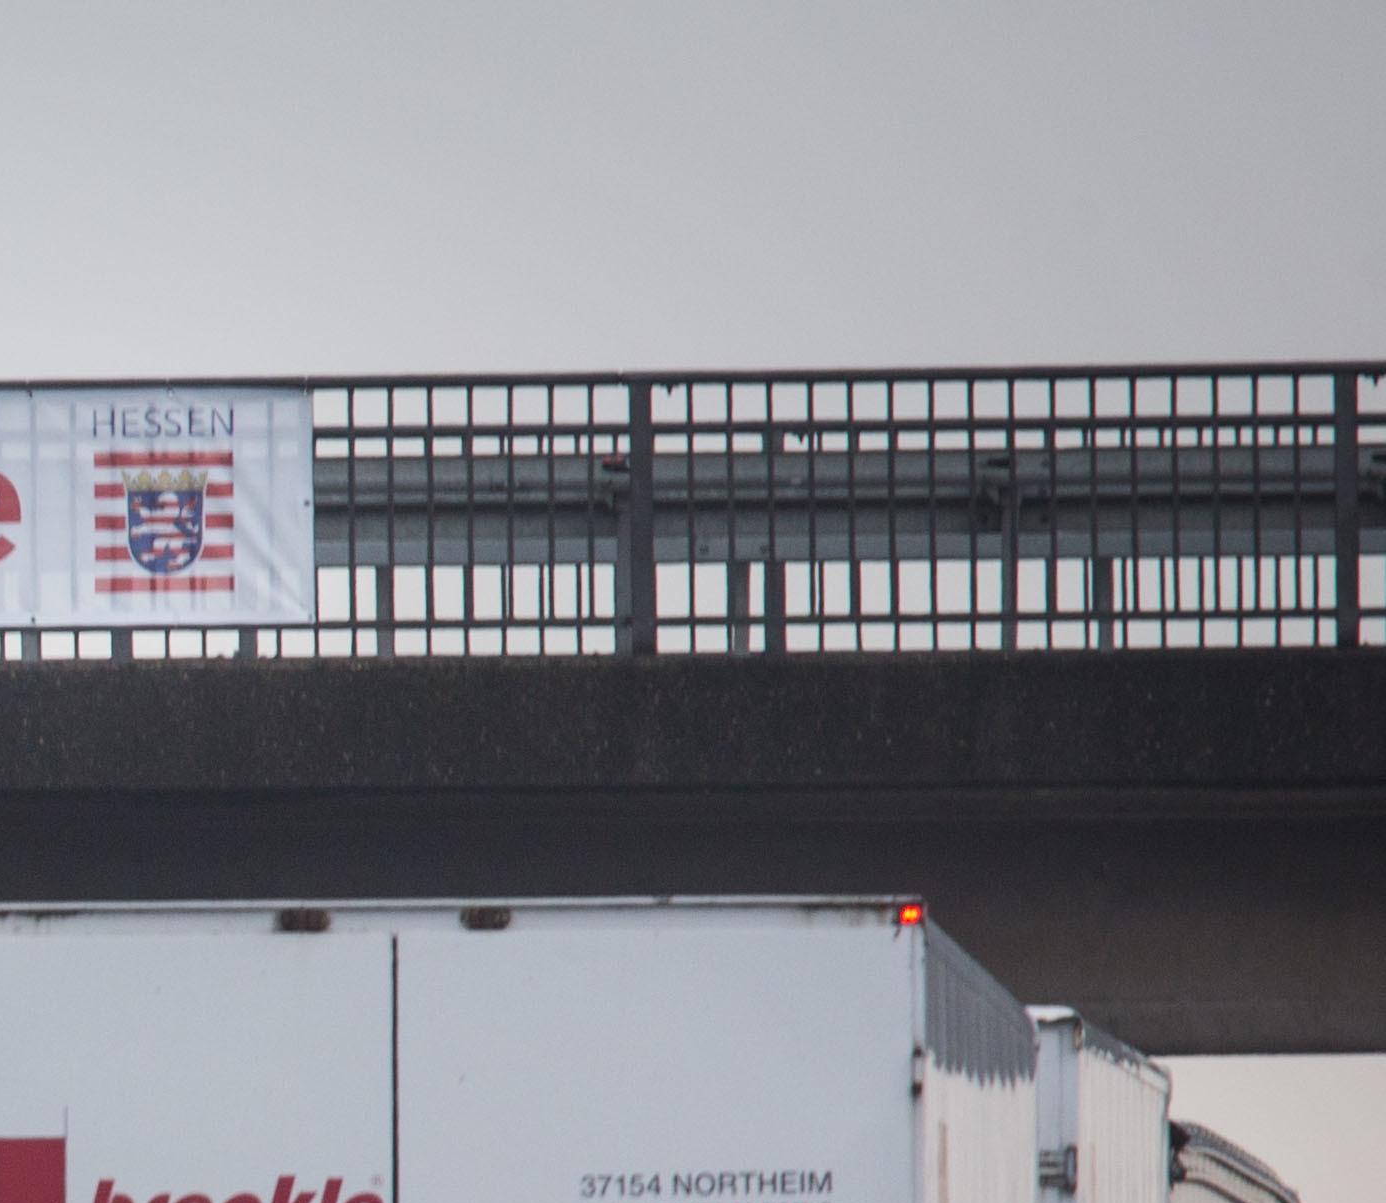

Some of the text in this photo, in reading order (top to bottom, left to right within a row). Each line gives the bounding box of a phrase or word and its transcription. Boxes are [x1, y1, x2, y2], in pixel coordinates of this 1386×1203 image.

[93, 406, 234, 438] HESSEN
[581, 1171, 833, 1198] 37154 NORTHEIM
